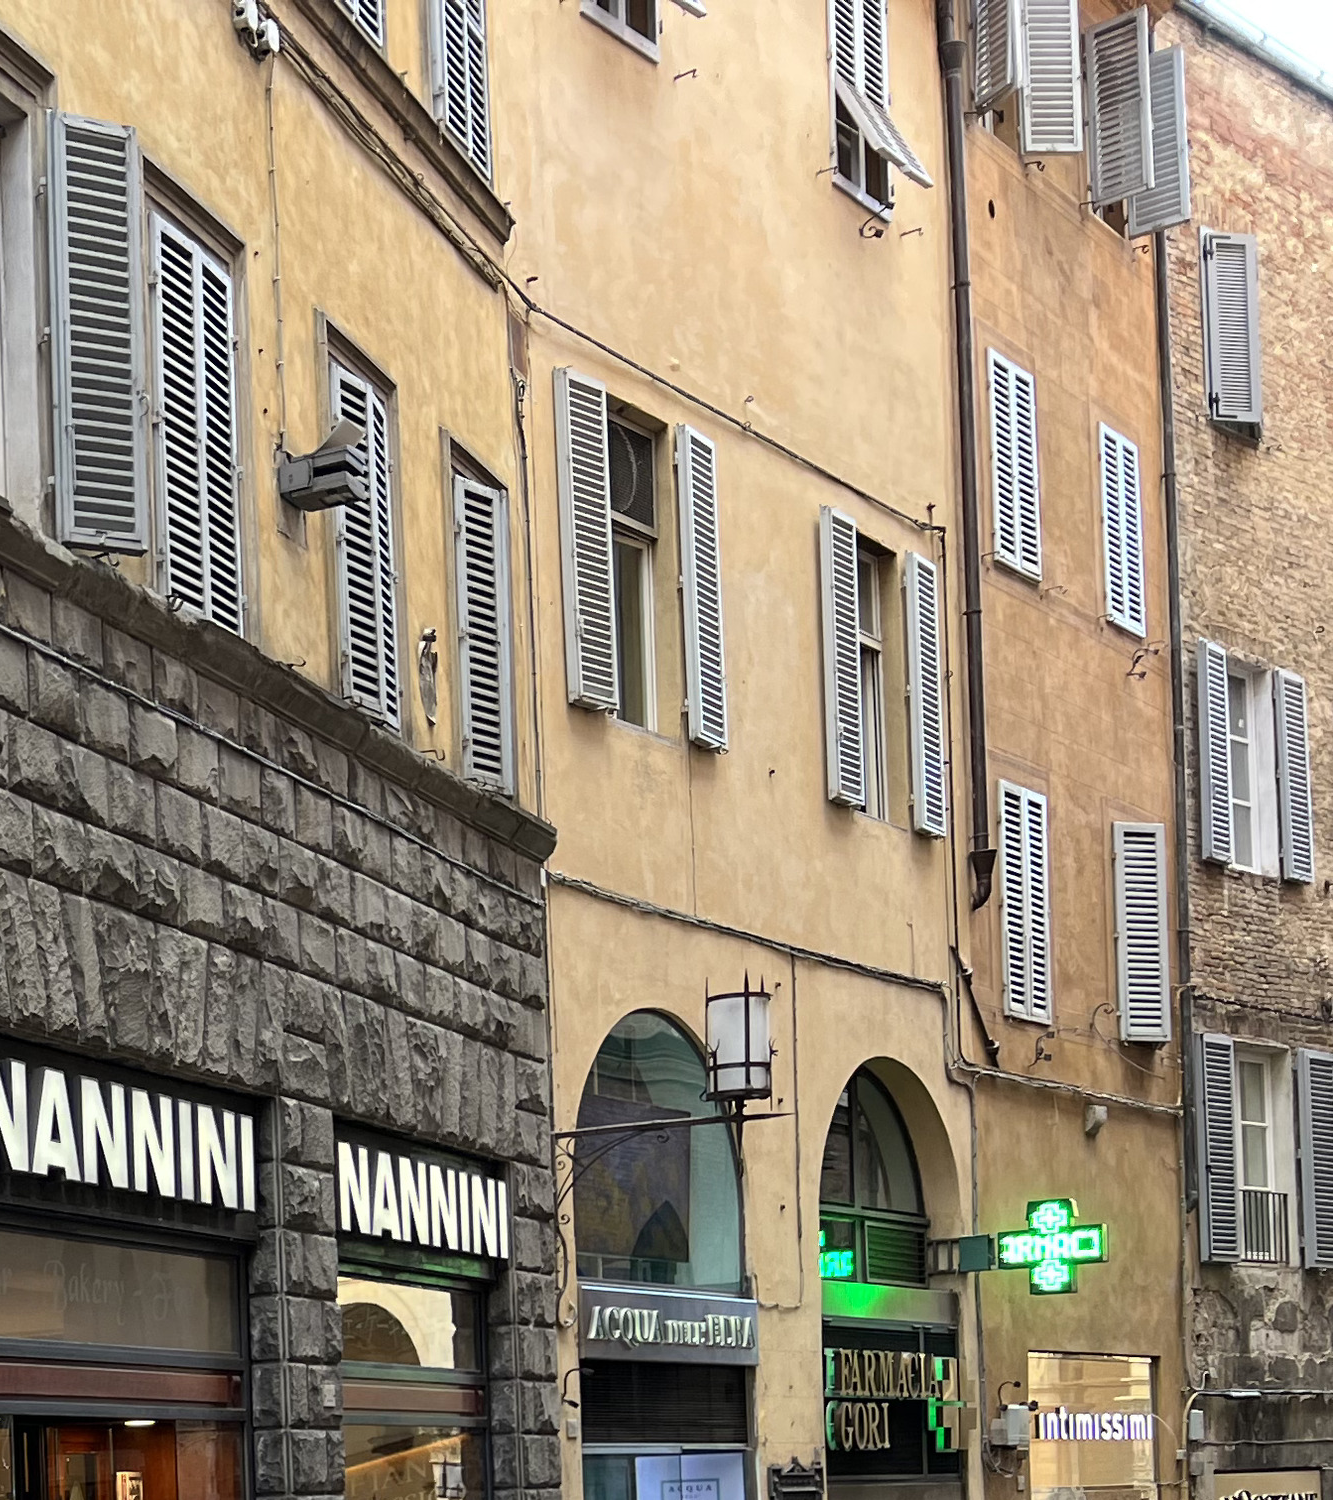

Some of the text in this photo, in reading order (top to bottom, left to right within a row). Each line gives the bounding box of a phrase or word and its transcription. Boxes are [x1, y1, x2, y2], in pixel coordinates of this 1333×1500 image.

[338, 1141, 509, 1259] NANNINI
[587, 1305, 663, 1349] ACQUA
[839, 1348, 941, 1399] FARMACIA
[841, 1402, 890, 1450] GORI
[1038, 1406, 1153, 1440] intimissimi
